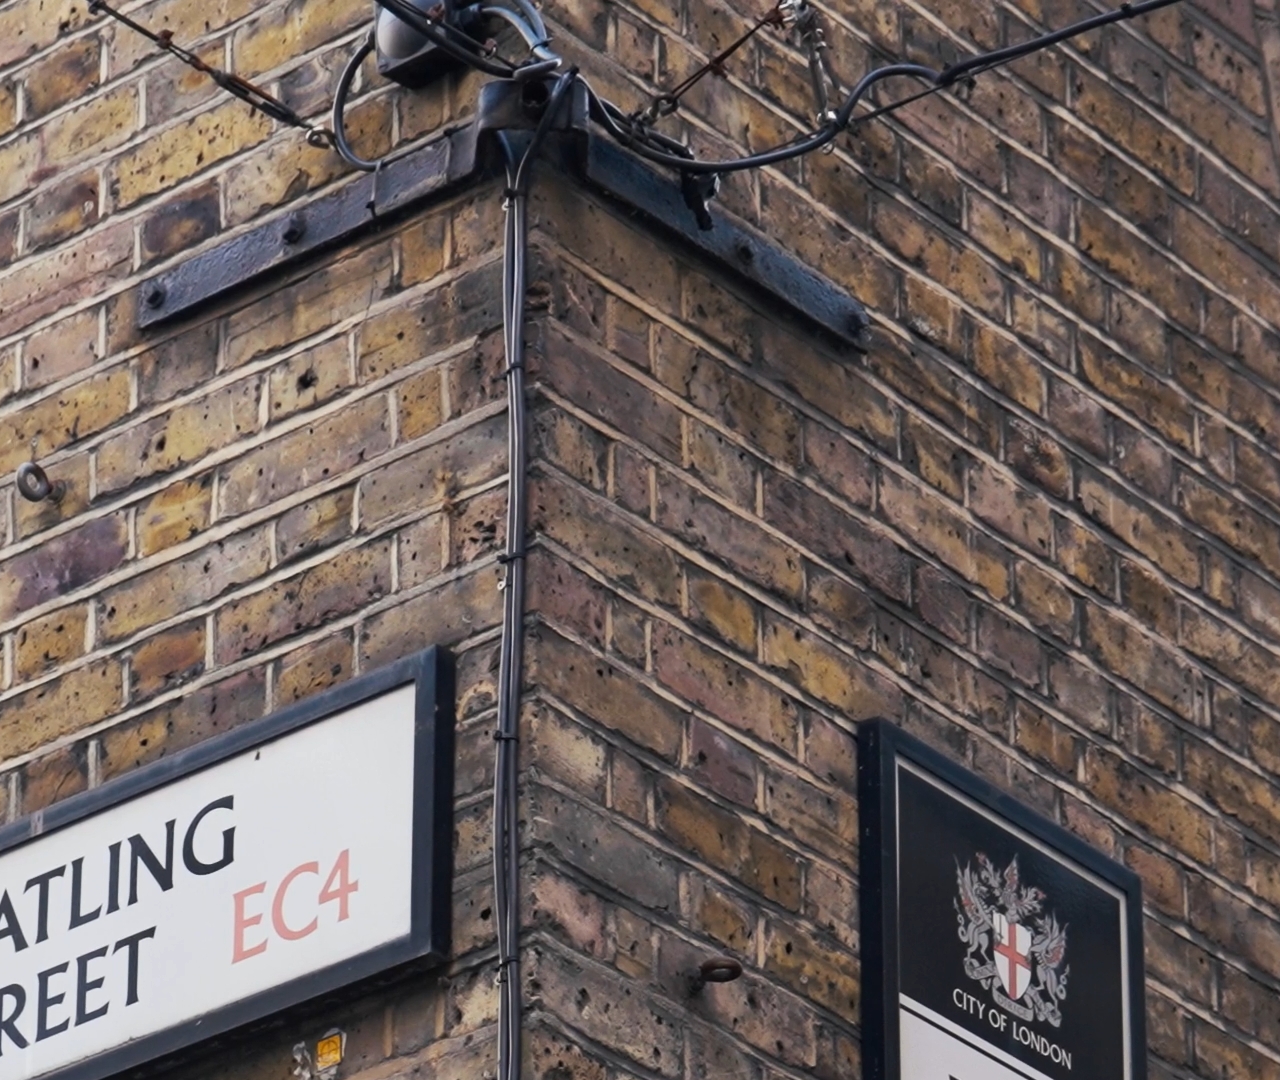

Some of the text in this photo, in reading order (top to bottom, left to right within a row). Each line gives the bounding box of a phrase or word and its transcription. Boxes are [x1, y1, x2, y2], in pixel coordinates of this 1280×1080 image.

[232, 850, 359, 963] EC4
[952, 988, 986, 1020] CITY
[988, 1008, 1008, 1032] OF
[1012, 1021, 1072, 1070] LONDON
